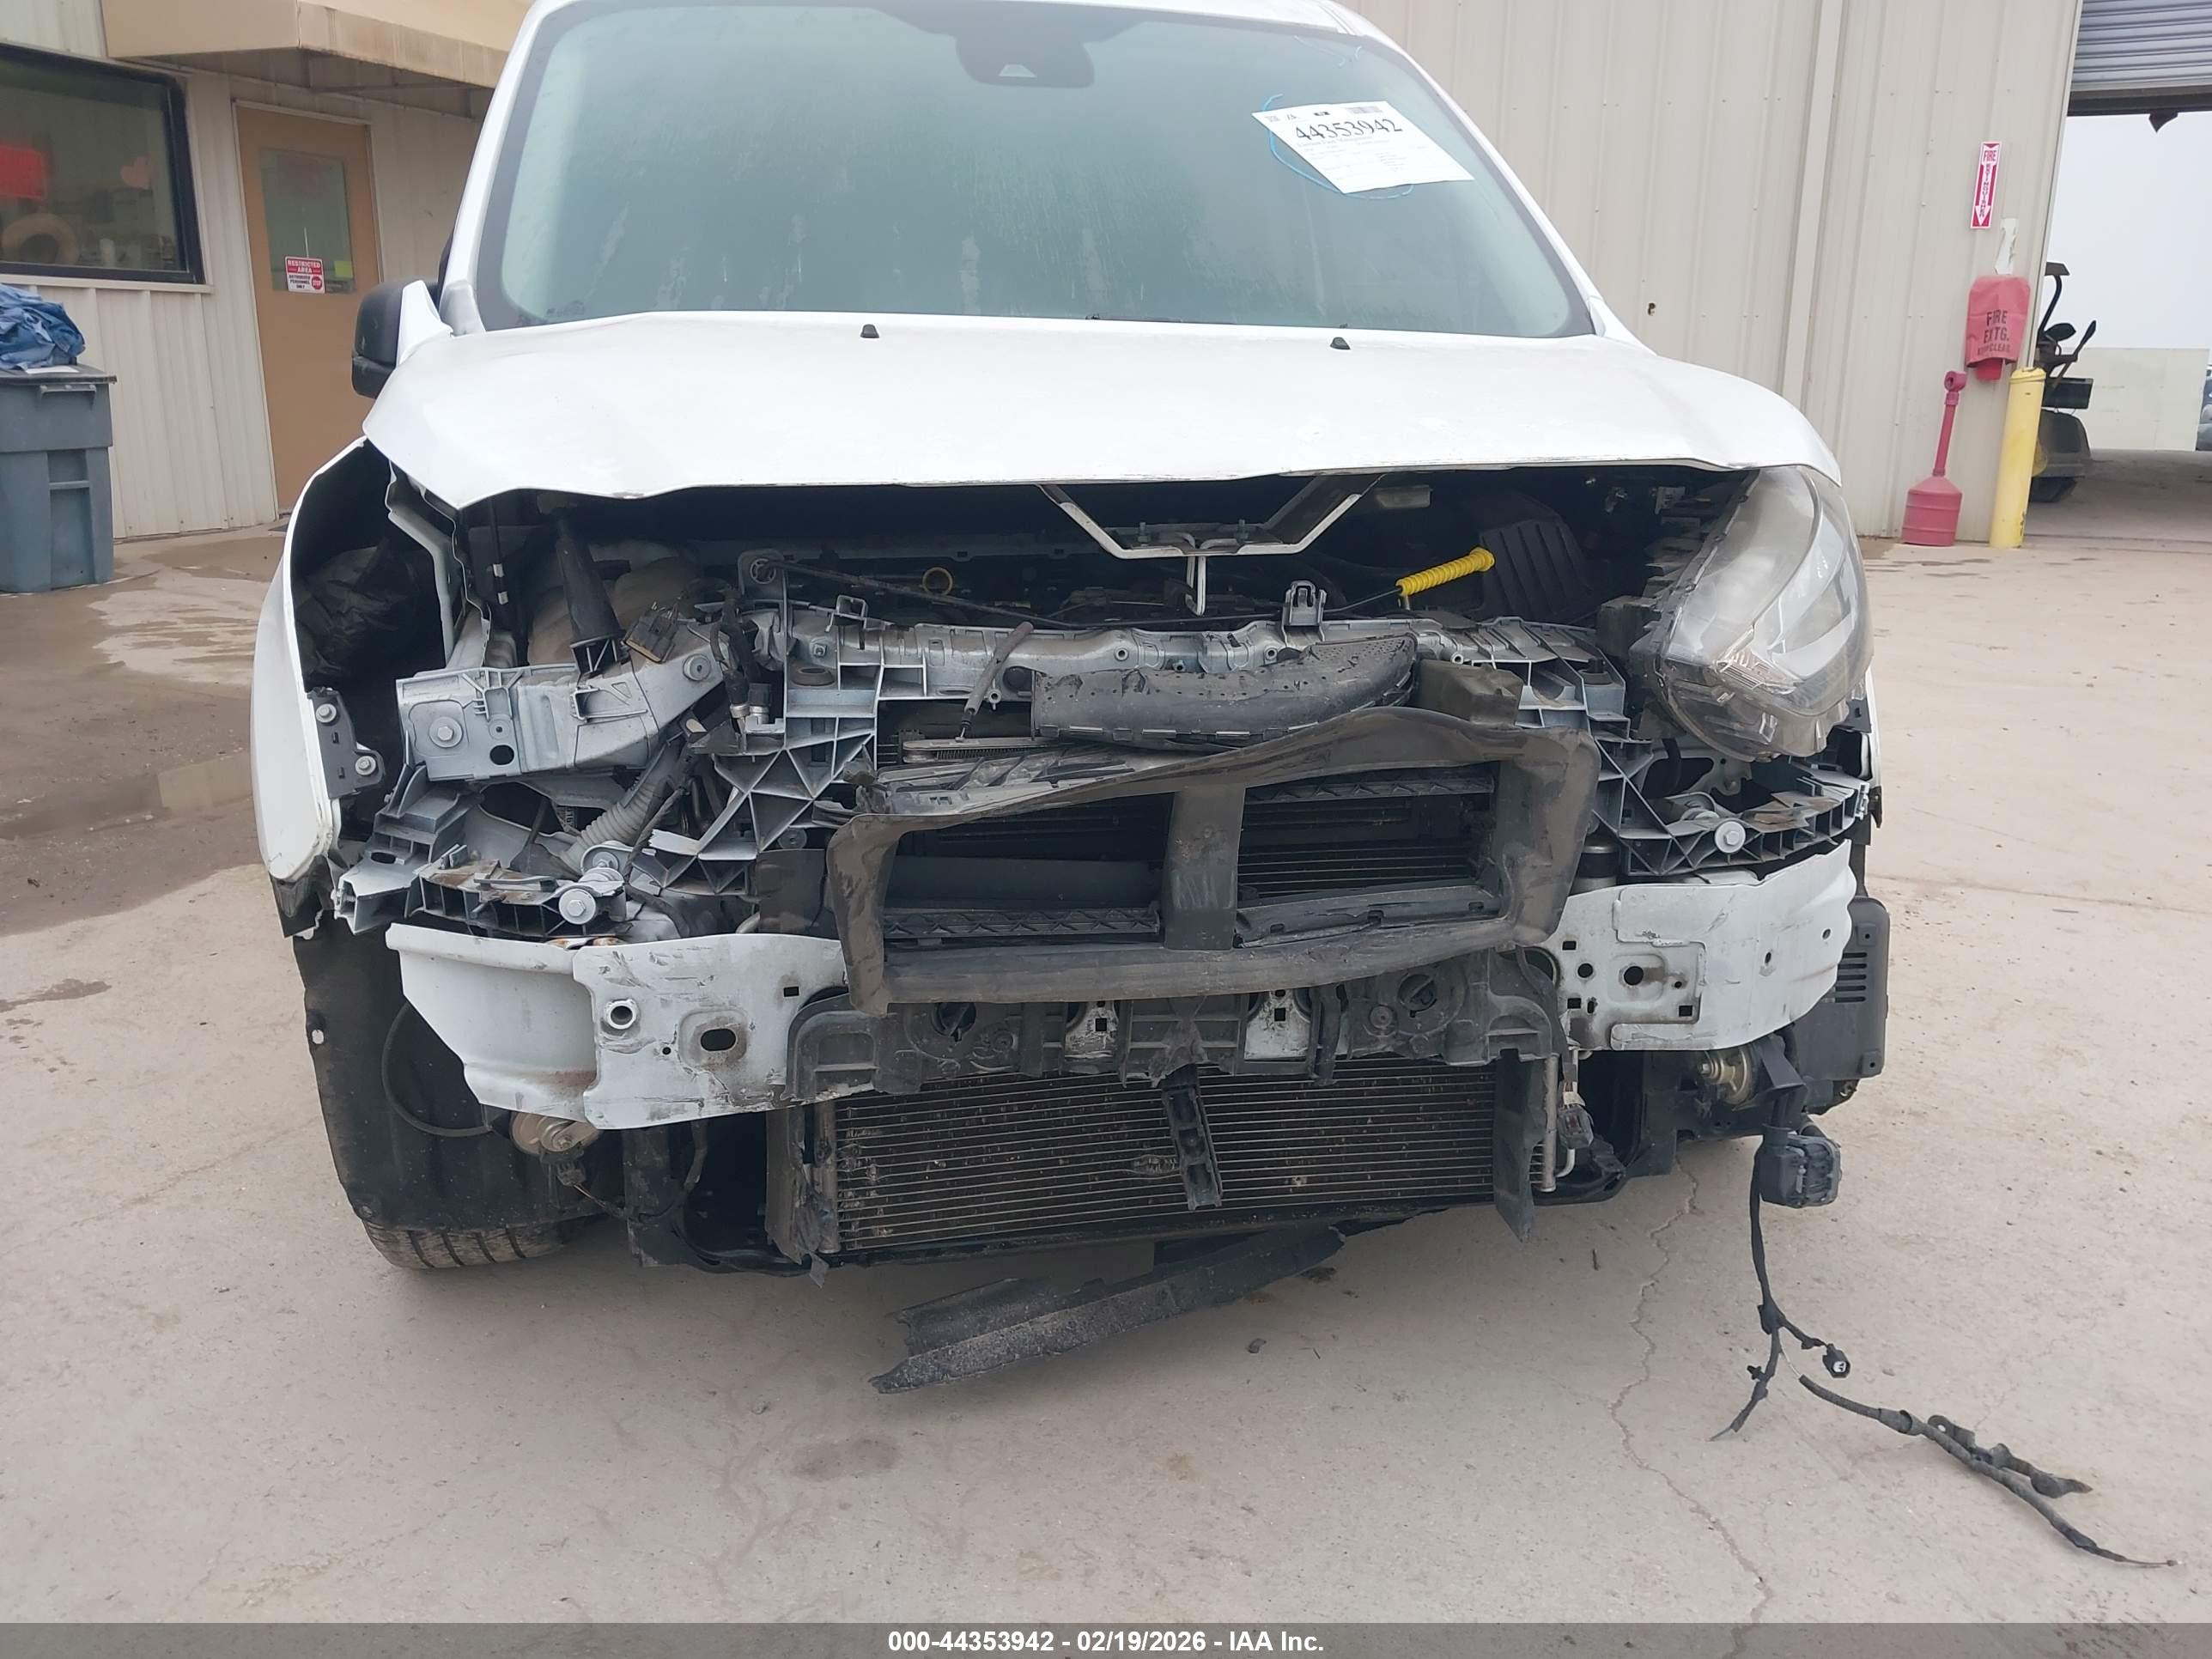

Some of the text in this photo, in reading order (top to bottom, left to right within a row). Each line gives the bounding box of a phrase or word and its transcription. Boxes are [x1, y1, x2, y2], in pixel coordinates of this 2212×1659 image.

[1296, 118, 1402, 141] 44353942
[1984, 150, 1996, 161] FIRE
[1986, 309, 2008, 326] FIRE
[1984, 326, 2010, 343] EXTG.
